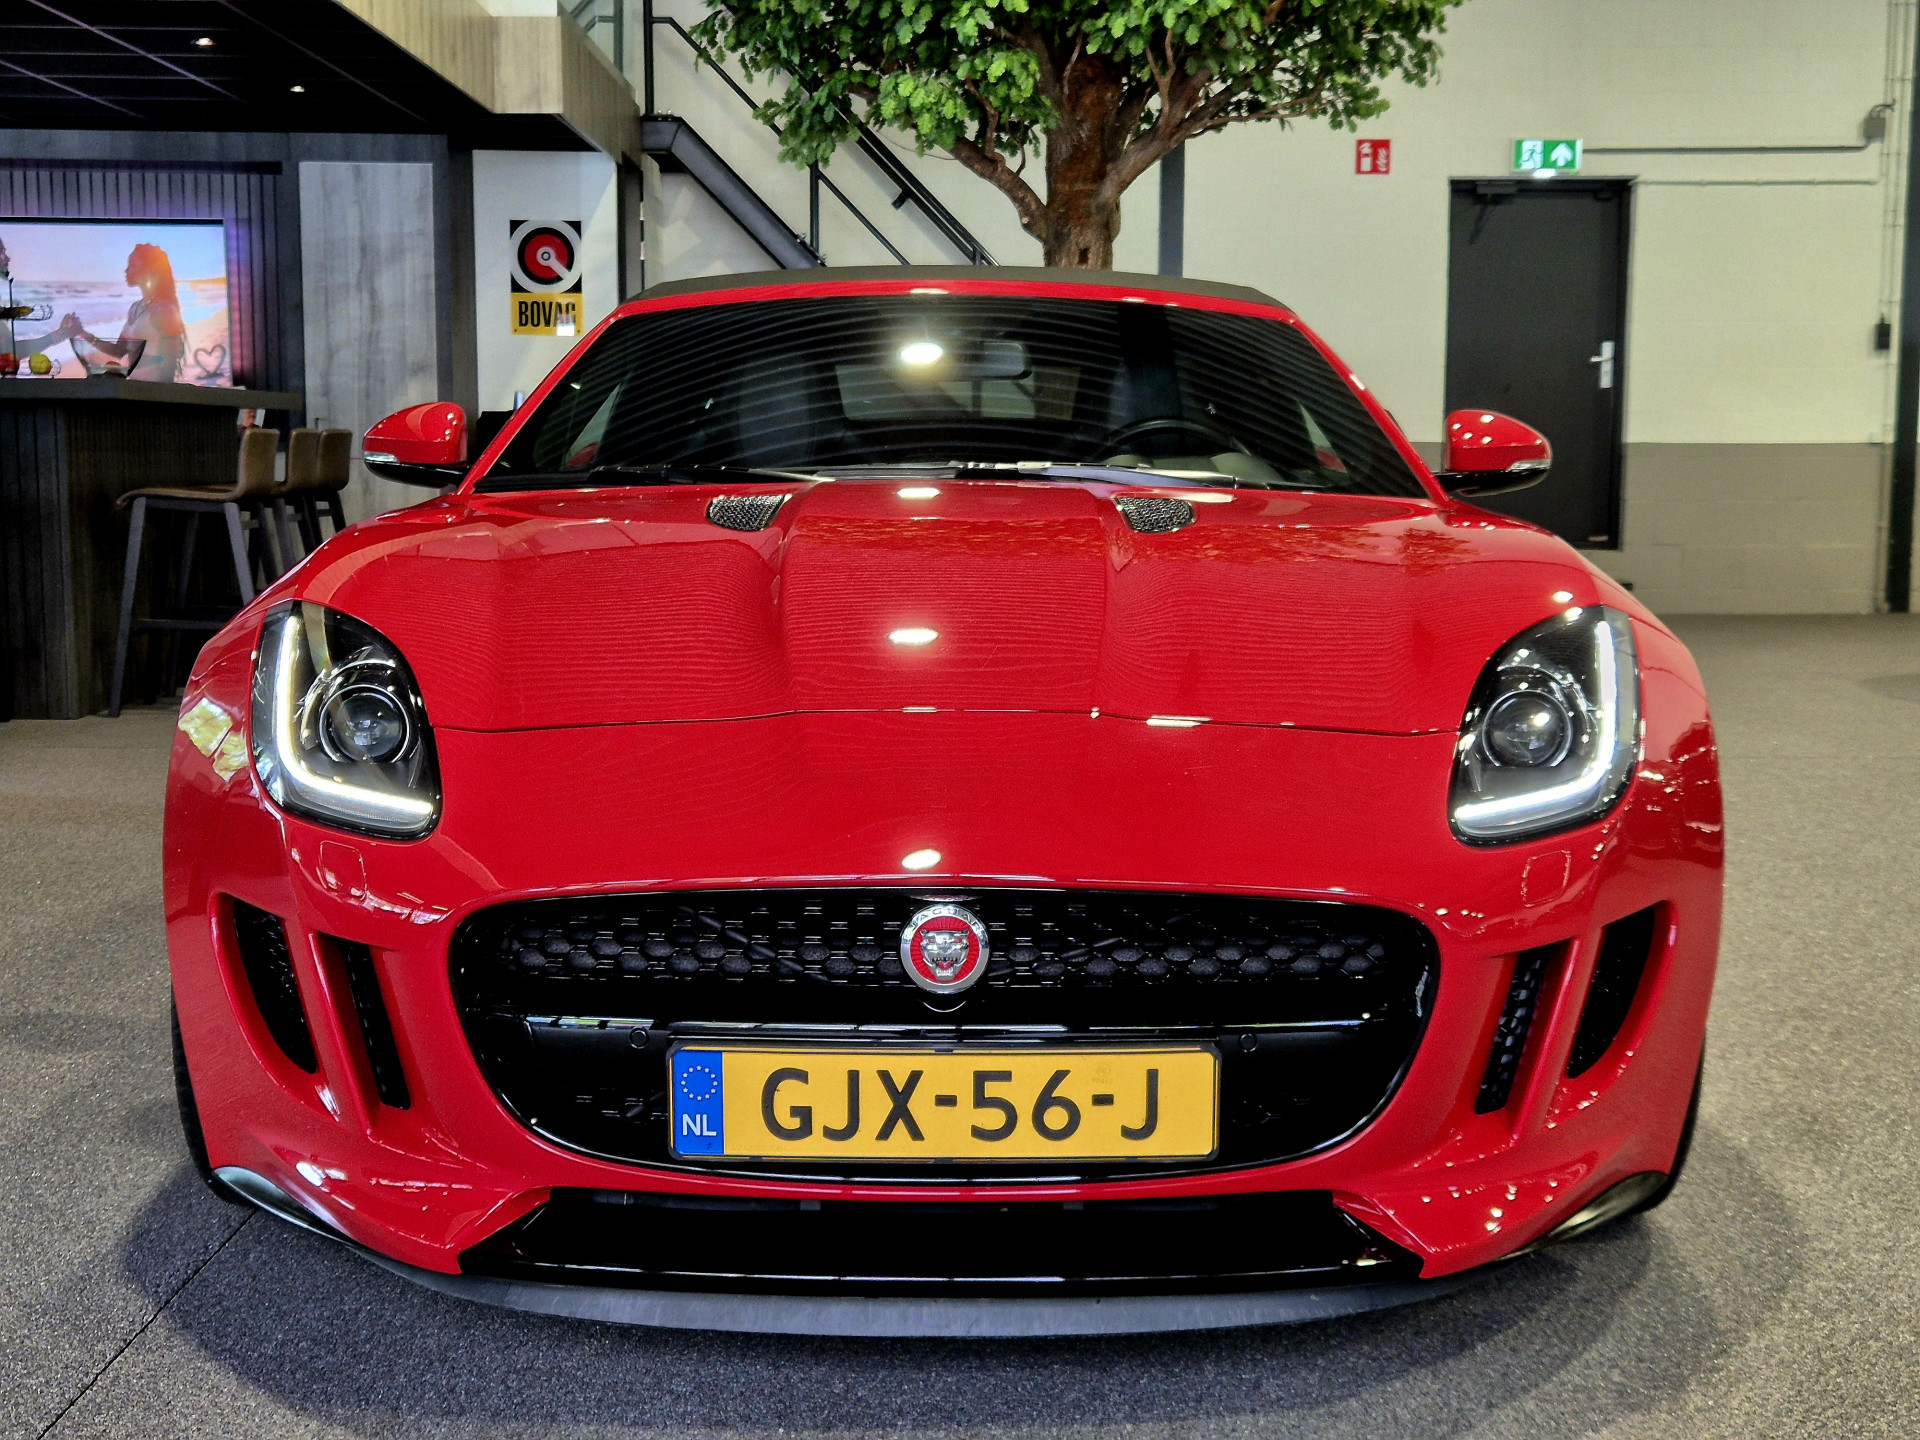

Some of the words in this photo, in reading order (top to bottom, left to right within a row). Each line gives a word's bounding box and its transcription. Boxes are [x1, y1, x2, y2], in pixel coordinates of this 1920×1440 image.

[518, 300, 577, 328] BOVAG
[760, 1067, 1160, 1142] GJX-56-J
[682, 1113, 717, 1136] NL
